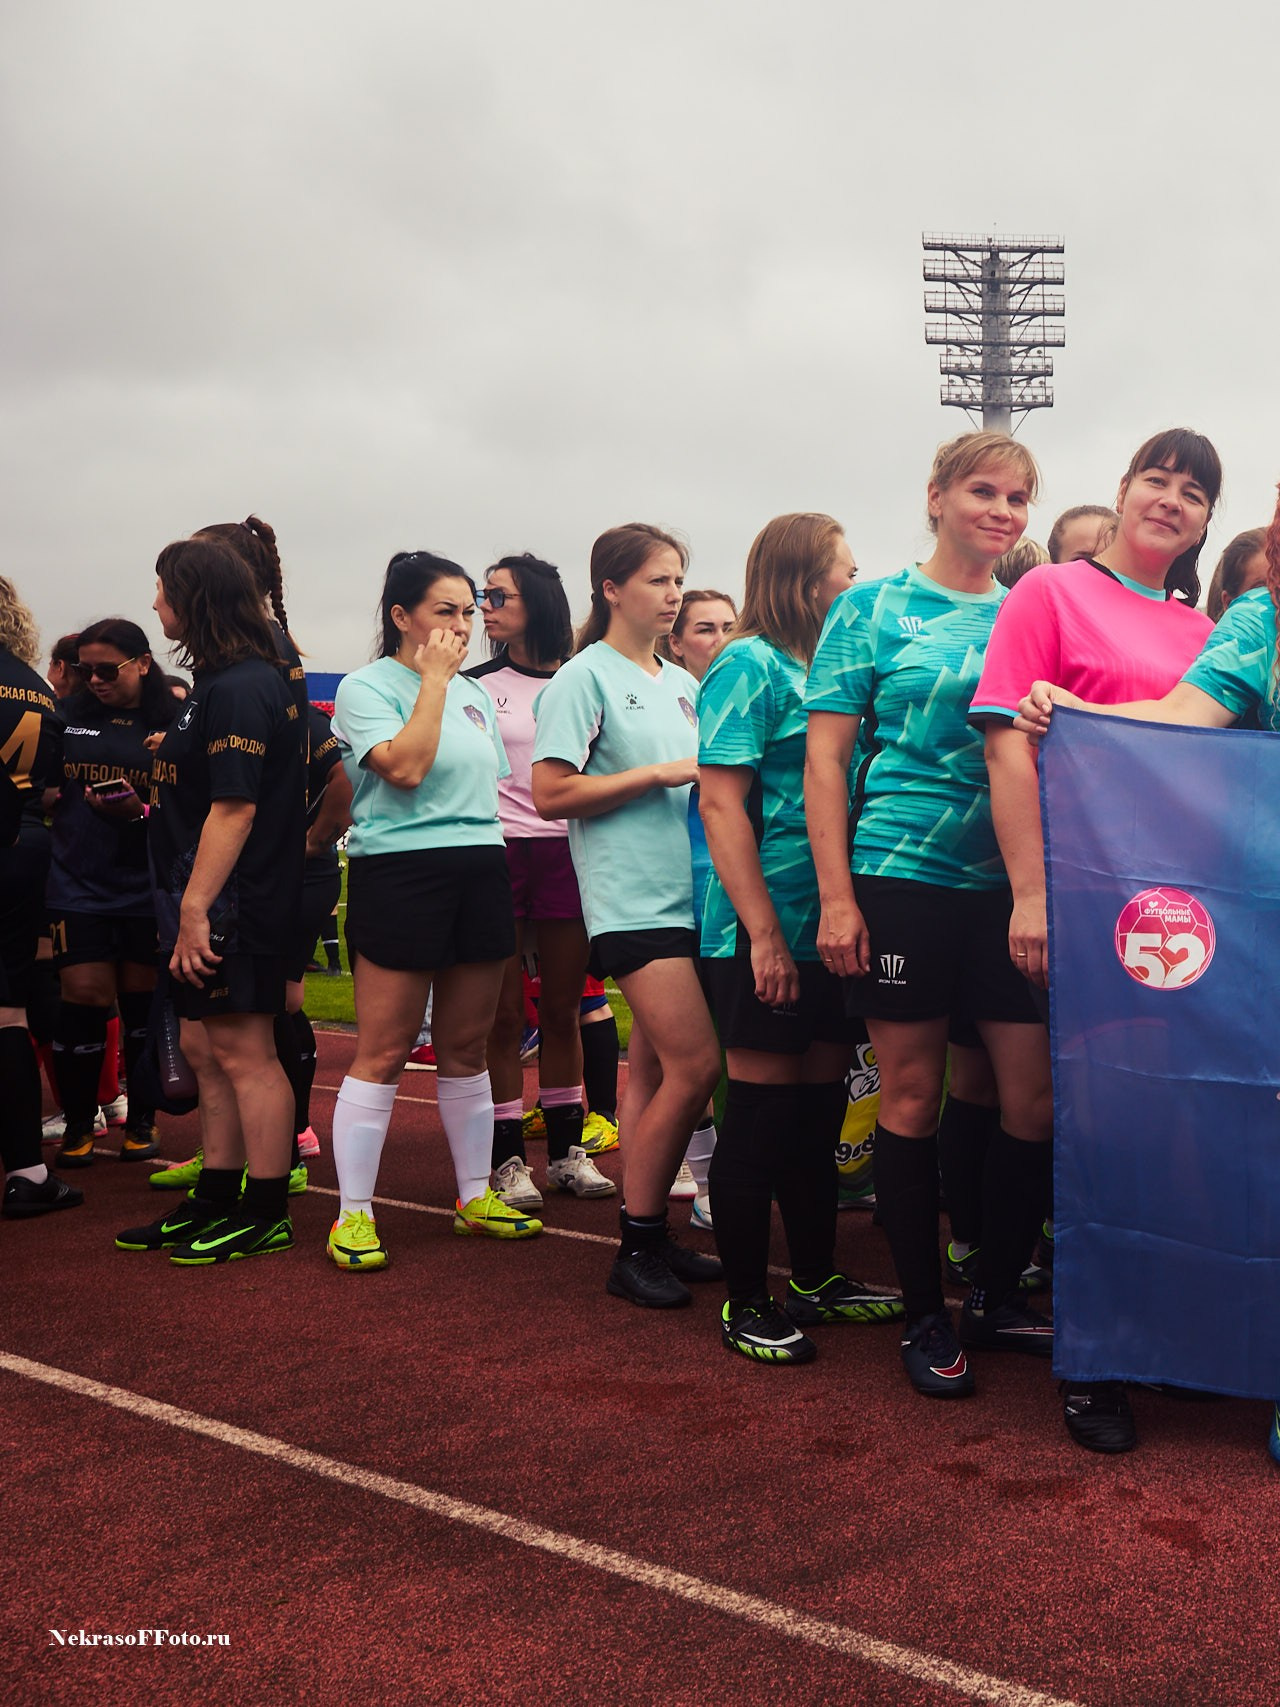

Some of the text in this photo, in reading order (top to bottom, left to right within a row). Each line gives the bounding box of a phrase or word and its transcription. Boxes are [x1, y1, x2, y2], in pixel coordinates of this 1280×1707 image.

[1144, 907, 1191, 916] ФУТБОЛЬНЫЕ
[1165, 915, 1191, 923] МАМЫ
[1124, 933, 1206, 988] 52
